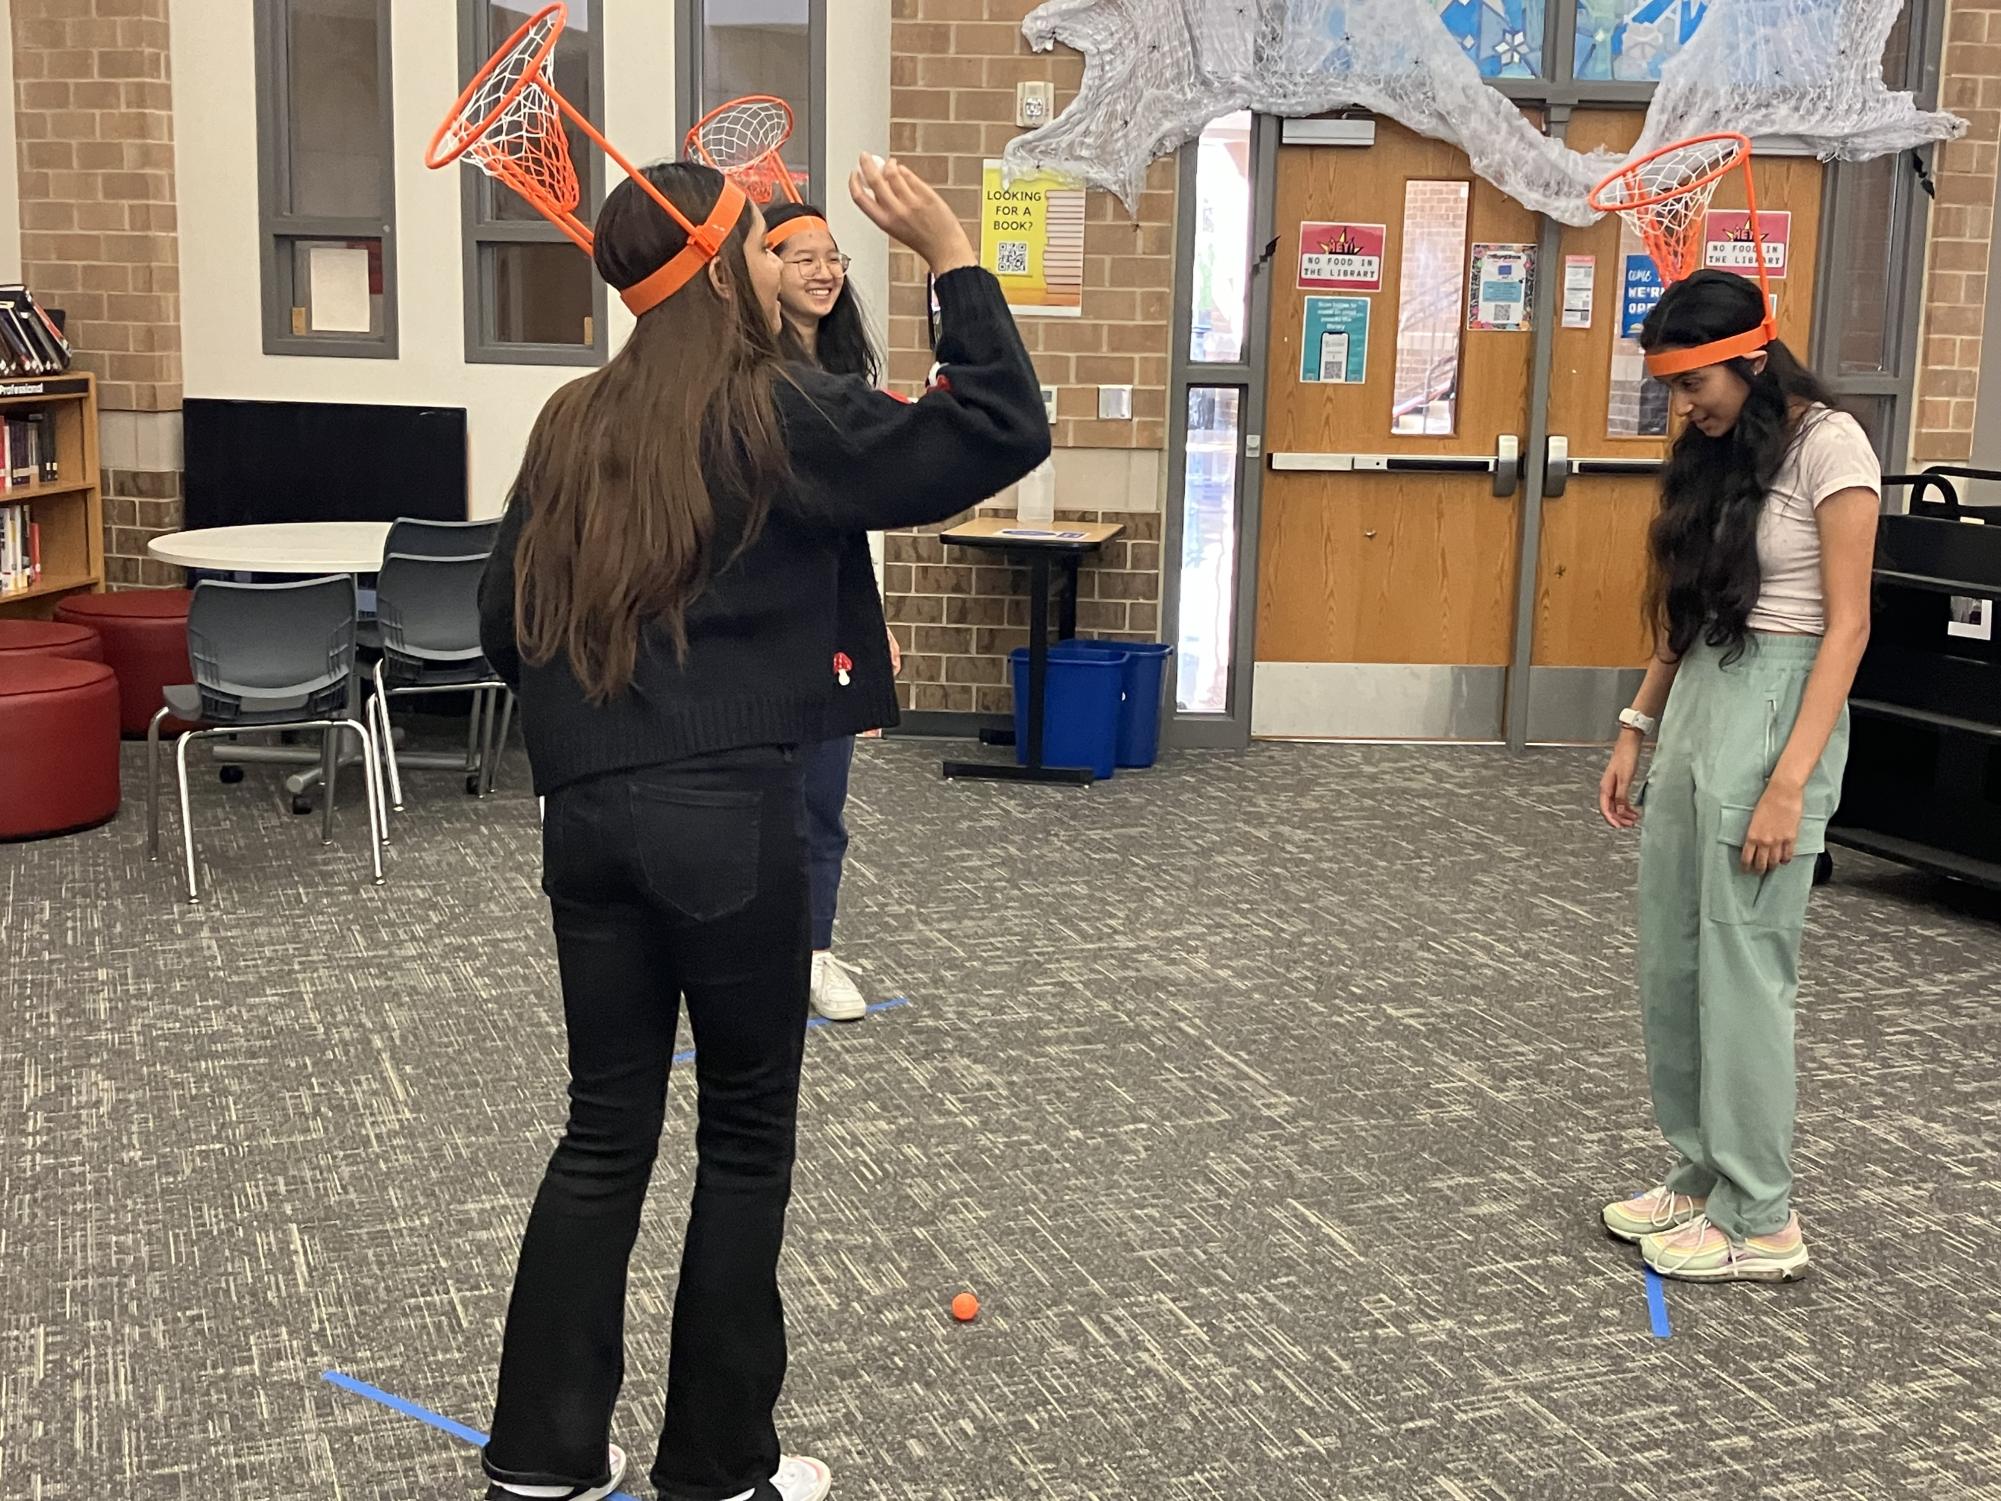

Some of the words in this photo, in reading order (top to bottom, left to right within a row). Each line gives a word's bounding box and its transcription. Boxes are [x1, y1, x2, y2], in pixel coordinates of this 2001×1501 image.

[987, 190, 1041, 202] LOOKING
[995, 205, 1018, 216] FOR
[1023, 206, 1031, 216] A
[993, 220, 1033, 231] BOOK?
[1712, 244, 1725, 252] NO
[1308, 257, 1320, 265] NO
[1327, 257, 1353, 266] FOOD
[1361, 258, 1373, 267] IN
[1708, 255, 1727, 264] THE
[1735, 256, 1780, 265] LIBRY
[1303, 268, 1322, 277] THE
[1330, 269, 1375, 279] LIBRARY
